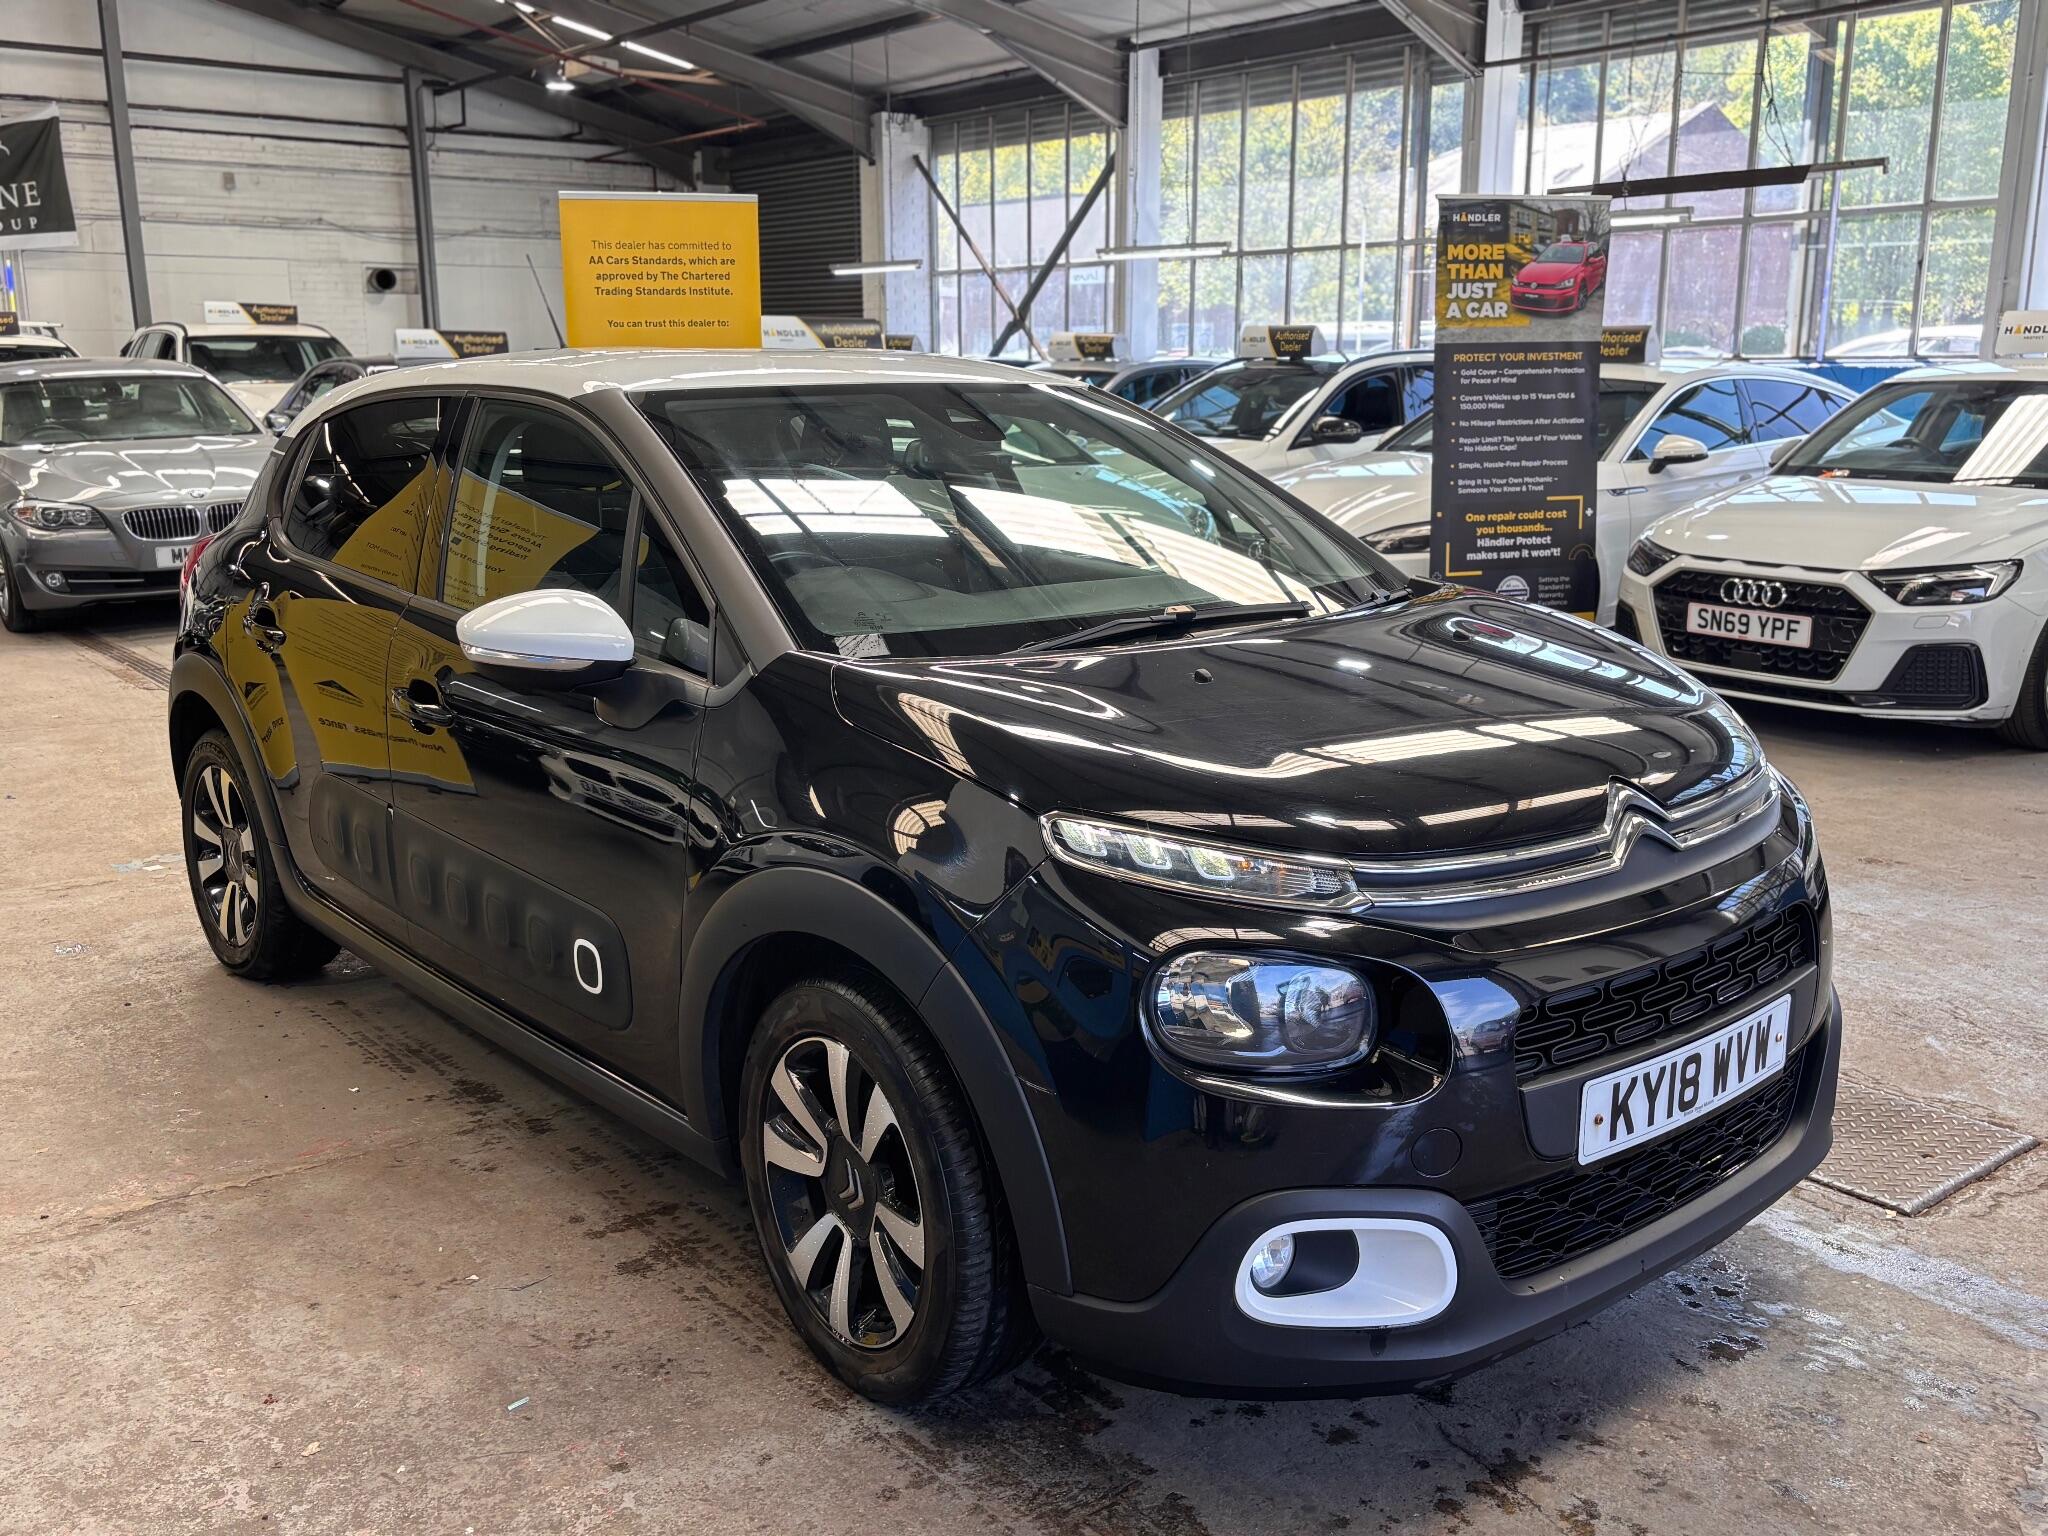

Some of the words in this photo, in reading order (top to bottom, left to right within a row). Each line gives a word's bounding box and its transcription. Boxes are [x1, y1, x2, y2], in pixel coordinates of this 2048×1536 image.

[591, 240, 613, 250] This
[615, 240, 646, 250] dealer
[648, 241, 666, 250] has
[668, 241, 720, 251] committed
[722, 242, 732, 251] to
[1447, 244, 1505, 261] MORE
[589, 256, 604, 265] AA
[606, 256, 630, 265] Cars
[632, 256, 687, 266] Standards,
[688, 257, 718, 266] which
[720, 258, 736, 266] are
[1447, 263, 1504, 280] THAN
[596, 272, 644, 282] approved
[646, 272, 658, 283] by
[660, 272, 679, 281] The
[681, 272, 731, 281] Chartered
[594, 287, 633, 297] Trading
[635, 287, 687, 296] Standards
[689, 287, 734, 296] Institute.
[1446, 282, 1497, 299] JUST
[1446, 302, 1462, 319] A
[1465, 302, 1508, 318] CAR
[607, 320, 625, 328] You
[644, 320, 667, 328] trust
[668, 320, 686, 328] this
[687, 319, 716, 328] dealer
[717, 320, 730, 328] to:
[821, 324, 876, 336] Authorised
[833, 336, 868, 348] Dealer
[1454, 353, 1497, 362] PROTECT
[1499, 352, 1525, 361] YOUR
[1527, 351, 1583, 361] INVESTMENT
[1460, 368, 1477, 376] Gold
[1503, 367, 1552, 376] Comprehensive
[1553, 367, 1585, 375] Protection
[1484, 393, 1511, 401] Vehicles
[1497, 418, 1534, 426] Restrictions
[1459, 436, 1480, 444] Repair
[1559, 433, 1583, 441] Vehicle
[1483, 460, 1520, 468] Hassle-Free
[1465, 513, 1486, 522] One
[1487, 511, 1516, 522] repair
[1517, 510, 1544, 520] could
[1546, 509, 1568, 519] cost
[1476, 525, 1495, 536] you
[1516, 535, 1552, 546] Protect
[1466, 550, 1498, 560] makes
[1499, 550, 1520, 559] sure
[1521, 549, 1529, 558] it
[1530, 547, 1561, 558] won't!
[1697, 608, 1750, 635] SN69
[1757, 615, 1801, 641] YPF
[1609, 1052, 1702, 1142] KY18
[1712, 1014, 1773, 1098] WVW
